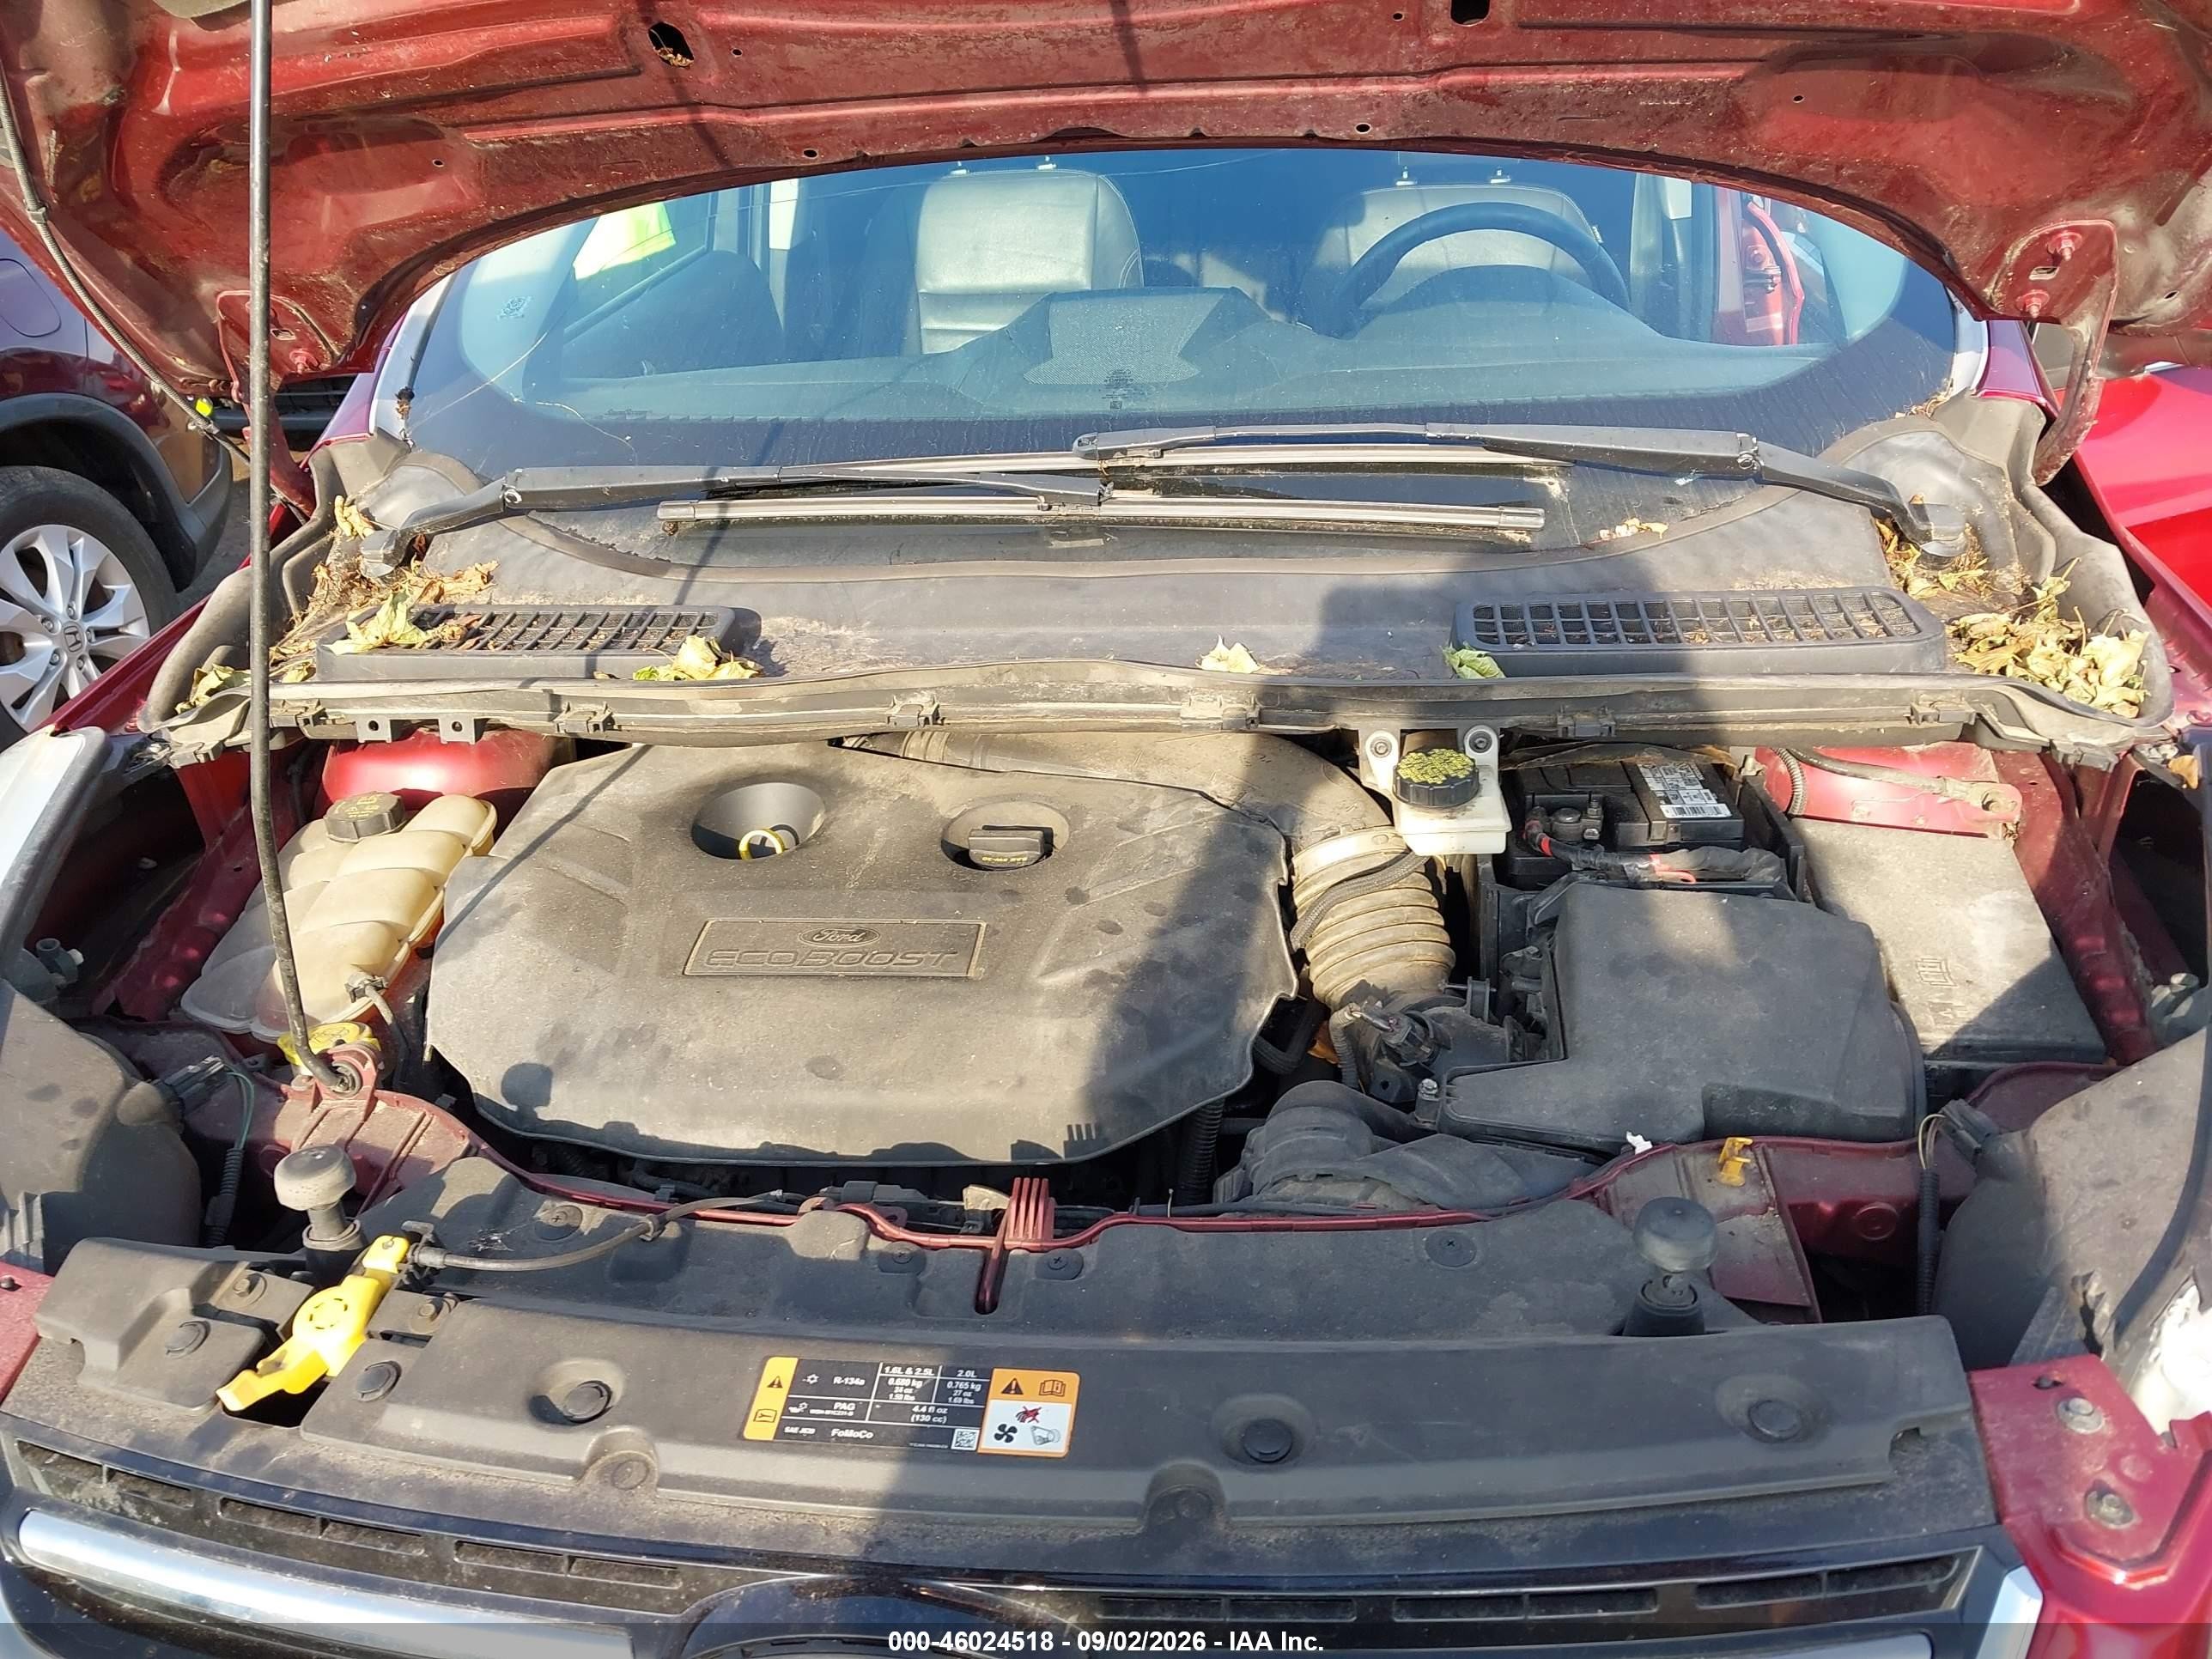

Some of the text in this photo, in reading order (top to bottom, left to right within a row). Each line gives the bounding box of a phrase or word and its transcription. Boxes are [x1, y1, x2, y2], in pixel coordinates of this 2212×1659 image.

[812, 927, 866, 943] Ford
[706, 949, 958, 968] ECOBOOST
[915, 1367, 935, 1376] 2.5L
[957, 1370, 977, 1378] 2.0L
[833, 1376, 866, 1386] R-134a
[911, 1379, 923, 1389] kg
[946, 1381, 981, 1392] 0.765 kg
[833, 1401, 855, 1411] PAG
[912, 1405, 927, 1413] 4.4
[910, 1414, 947, 1424] (130 cc)
[831, 1428, 874, 1439] FoMoCo
